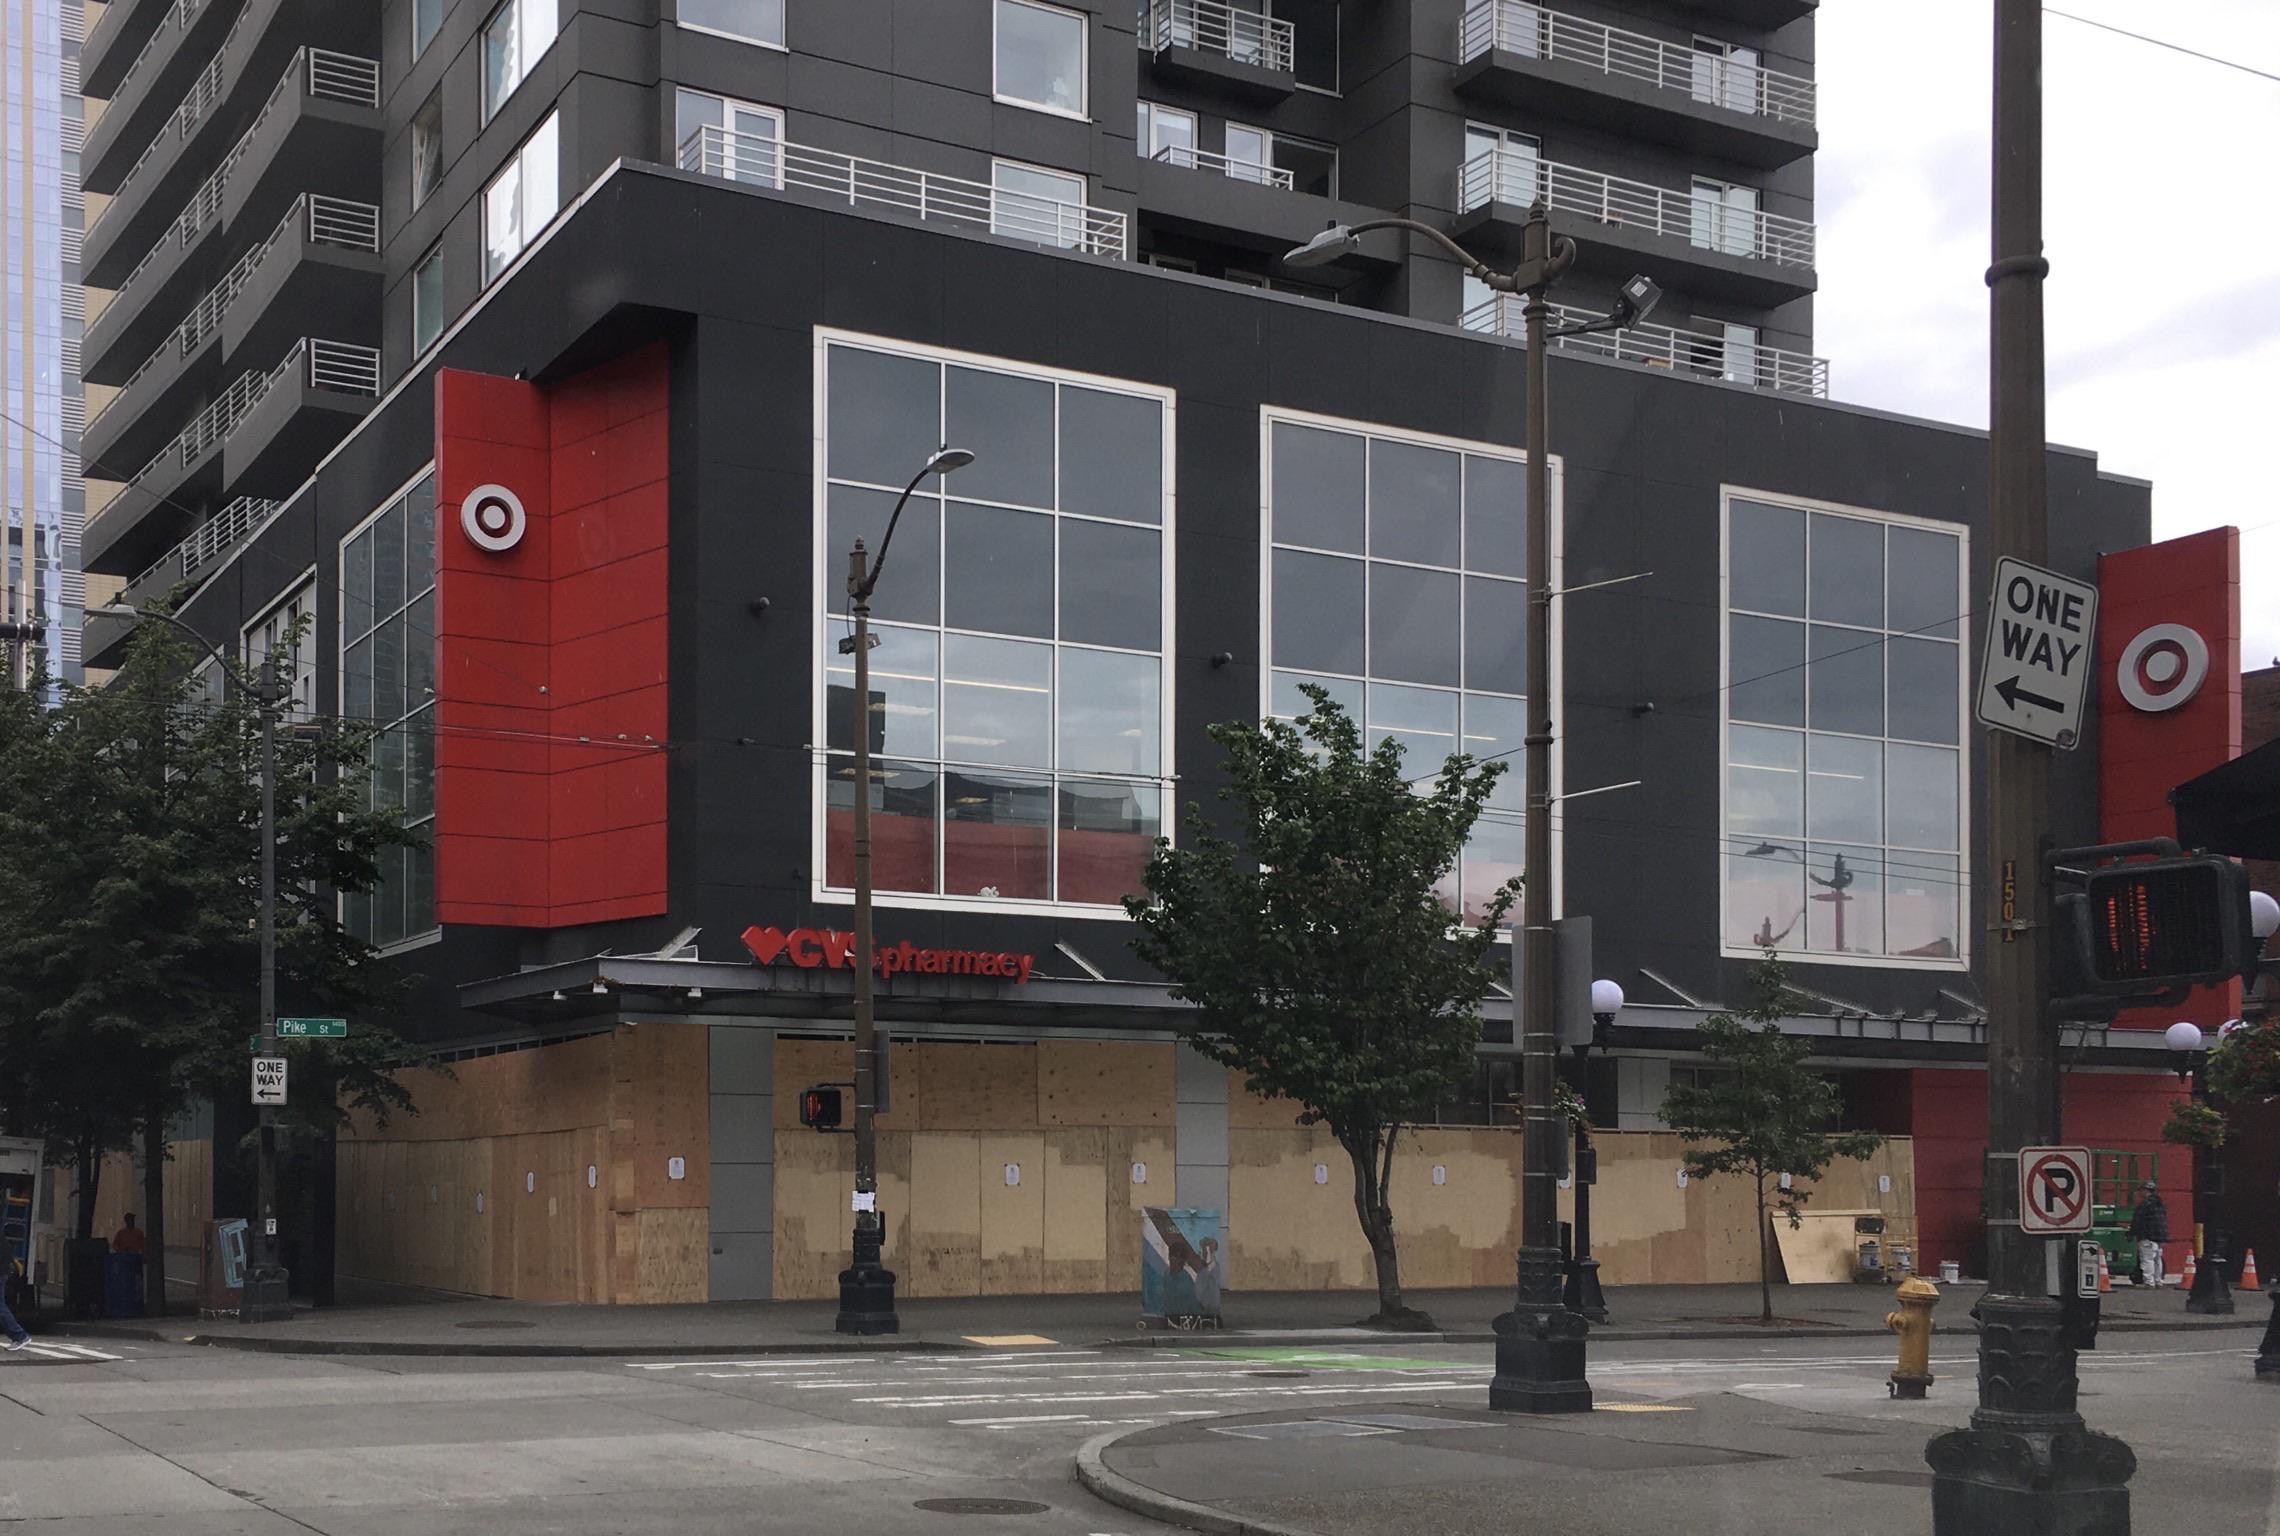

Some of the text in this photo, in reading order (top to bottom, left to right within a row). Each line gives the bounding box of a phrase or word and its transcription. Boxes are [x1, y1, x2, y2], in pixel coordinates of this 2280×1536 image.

[2007, 576, 2085, 633] ONE
[2002, 618, 2083, 677] WAY
[880, 940, 1035, 984] pharmacy
[283, 1020, 307, 1034] Pike
[319, 1024, 329, 1034] St
[256, 1061, 284, 1073] ONE
[256, 1074, 284, 1086] WAY
